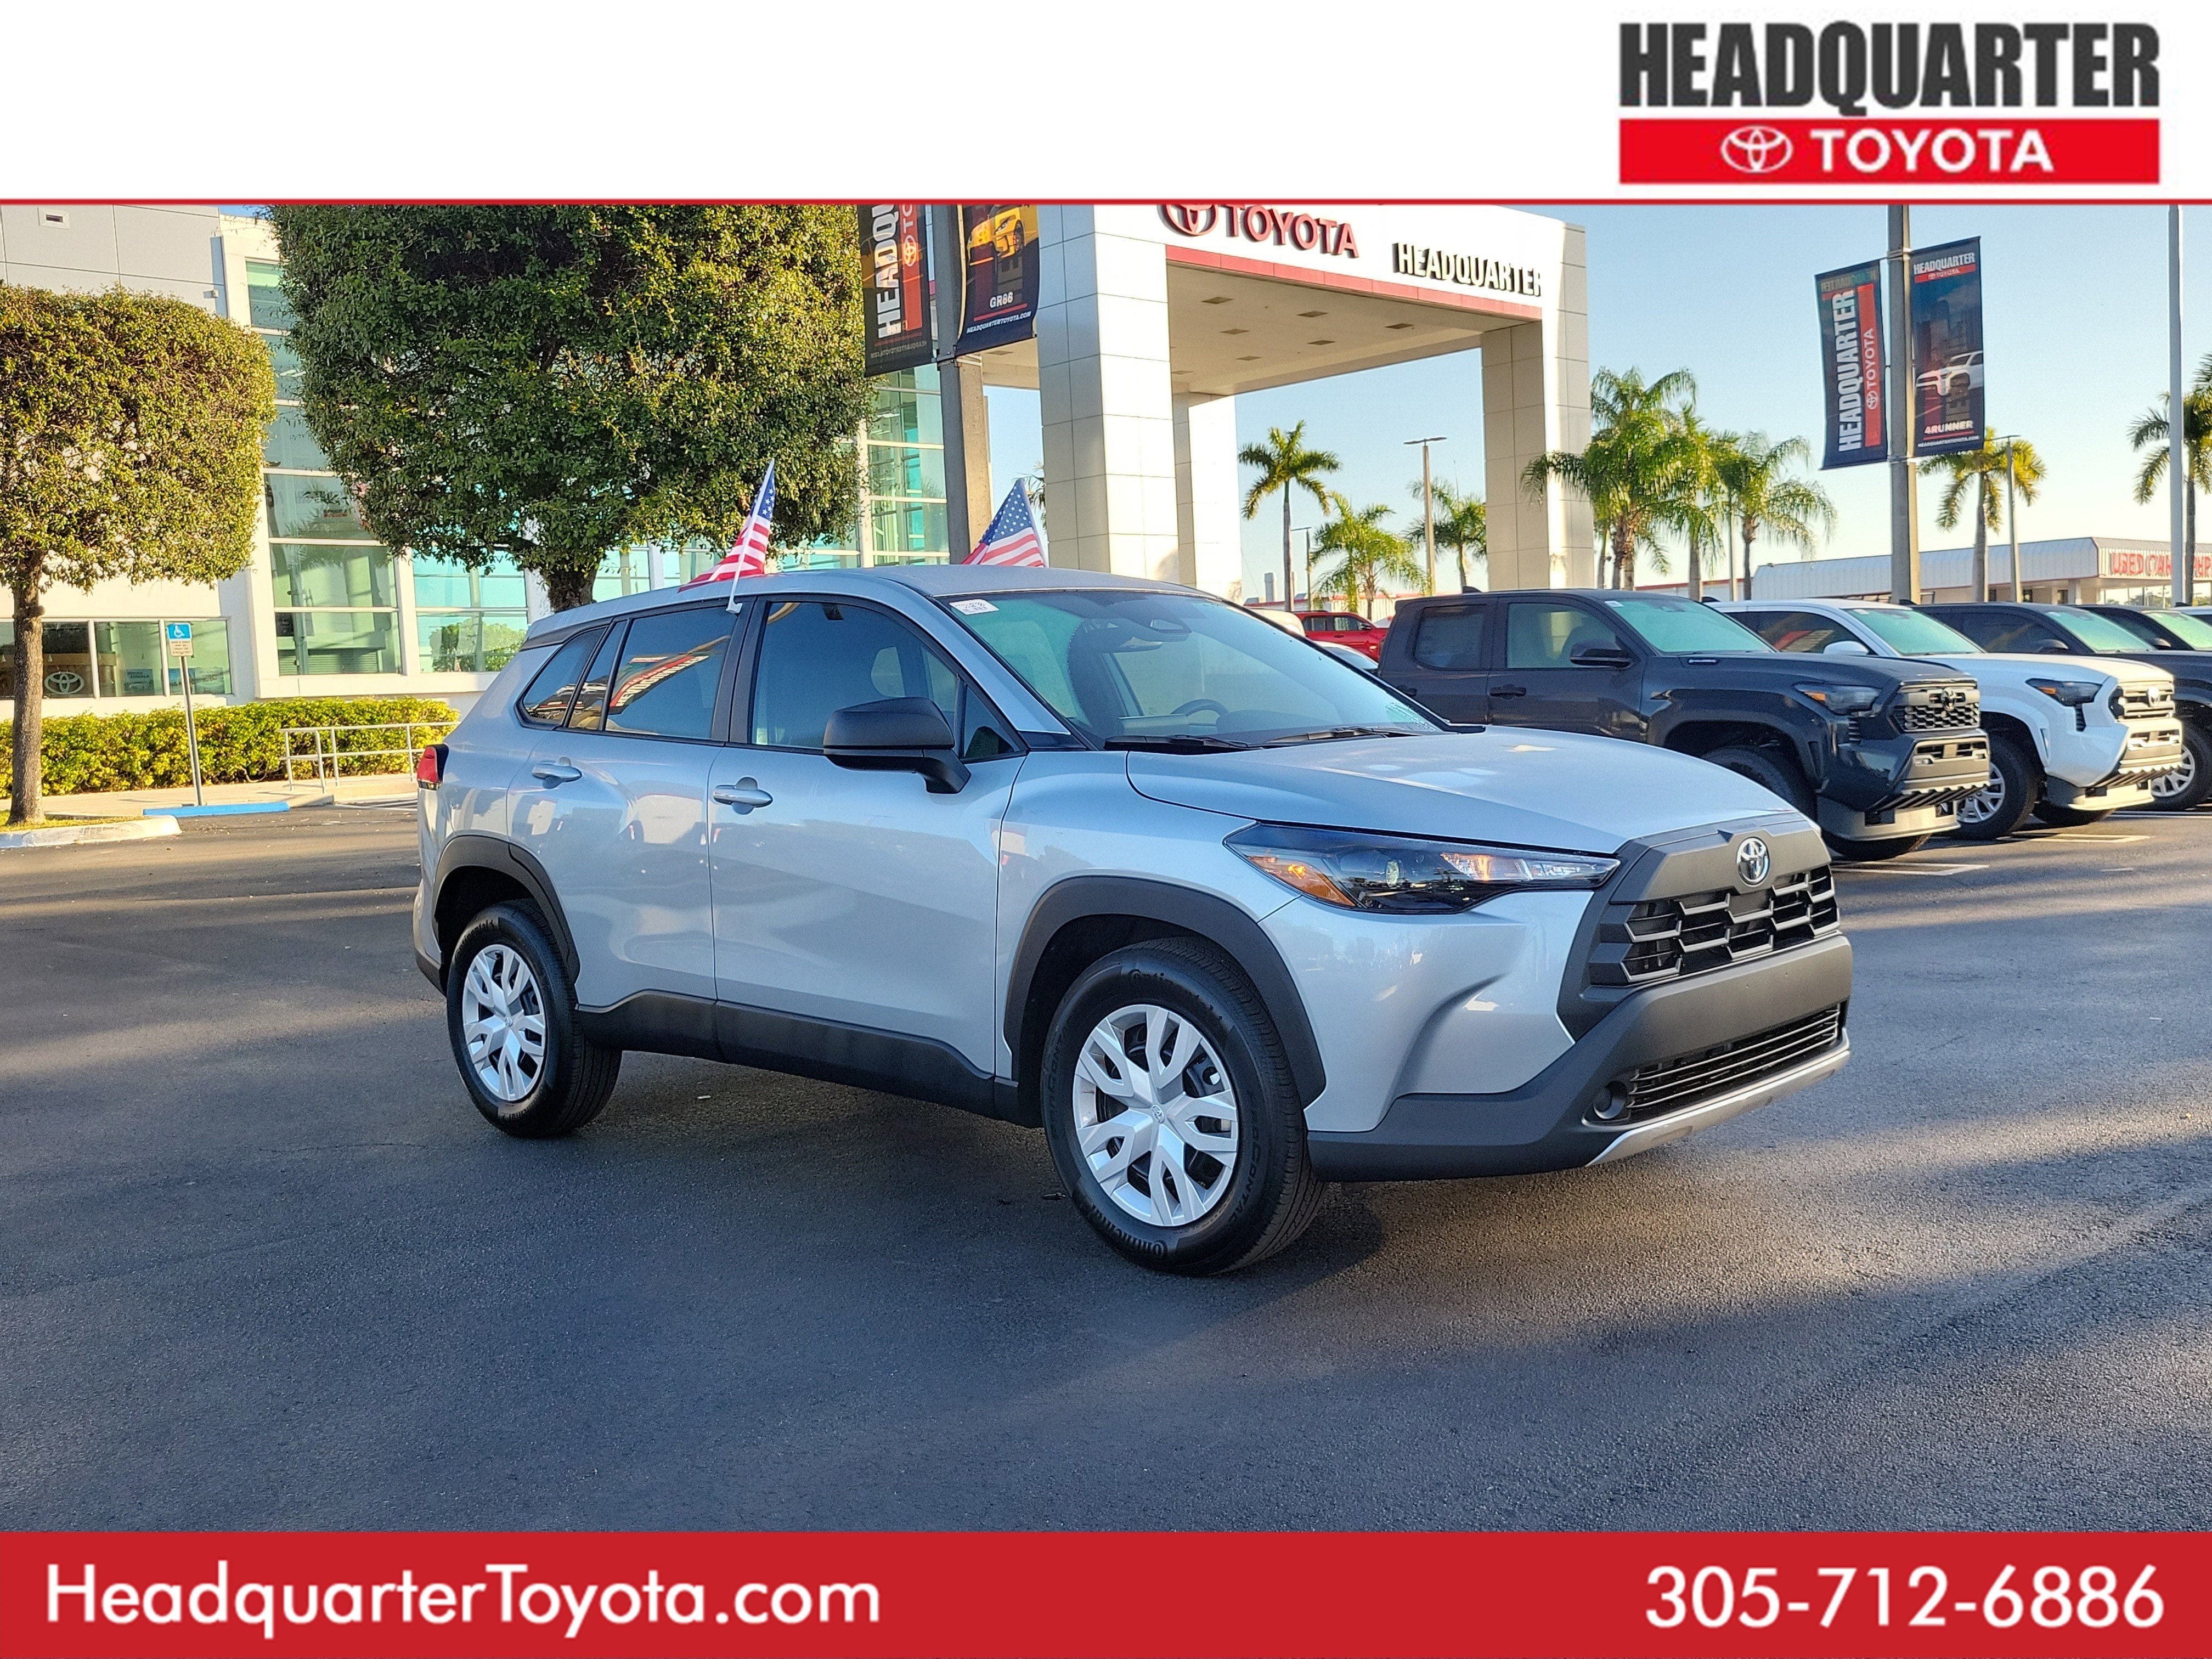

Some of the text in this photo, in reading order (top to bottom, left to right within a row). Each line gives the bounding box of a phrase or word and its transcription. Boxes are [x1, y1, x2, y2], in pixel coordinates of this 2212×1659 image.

[1218, 204, 1359, 258] TOYOTA
[1393, 242, 1542, 297] HEADQUARTER
[1913, 252, 1975, 275] HEADQUARTER
[1936, 268, 1961, 278] TOYOTA
[989, 291, 1014, 308] GR86
[966, 311, 1031, 334] HEADQUARTERTOYOTA.COM
[1832, 289, 1863, 452] HEADQUARTER
[1865, 328, 1877, 390] TOYOTA
[1924, 420, 1974, 435] 4RUNNER
[2112, 552, 2144, 575] USED
